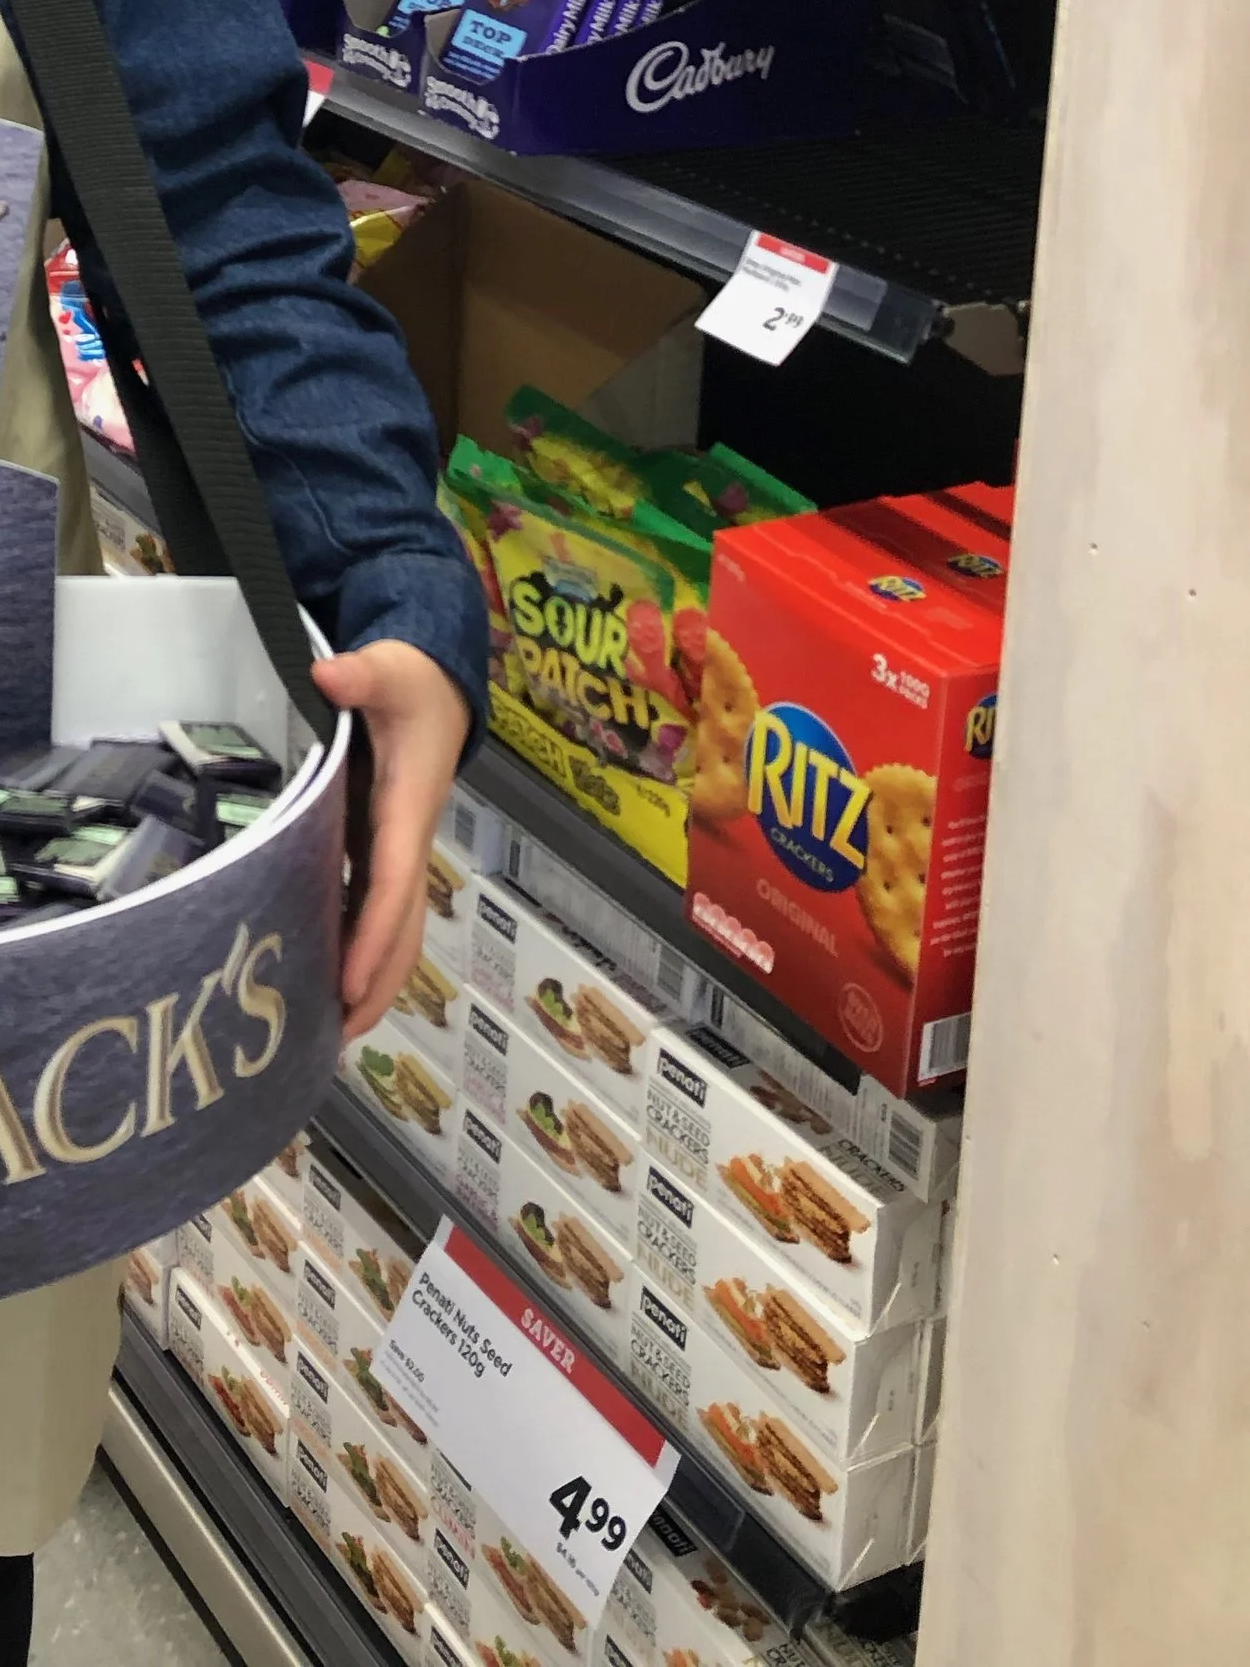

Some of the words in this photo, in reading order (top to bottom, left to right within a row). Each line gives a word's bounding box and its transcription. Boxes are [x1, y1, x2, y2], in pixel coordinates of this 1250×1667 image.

[471, 19, 512, 45] TOP
[626, 40, 775, 113] Cadbury
[512, 580, 628, 680] SOUR
[515, 635, 650, 729] PATCH
[747, 710, 874, 870] RITZ
[770, 827, 835, 882] CRACKERS
[756, 879, 839, 958] ORIGINAL
[660, 1057, 707, 1103] penati
[646, 1104, 709, 1166] CRACKERS
[837, 1138, 905, 1192] CRACKERS
[648, 1174, 693, 1222] penati
[412, 1290, 457, 1347] Crackers
[457, 1339, 486, 1379] 120g
[455, 1308, 481, 1345] Nuts
[479, 1338, 513, 1378] Seed
[521, 1308, 576, 1375] SAVER
[643, 1293, 687, 1344] penati
